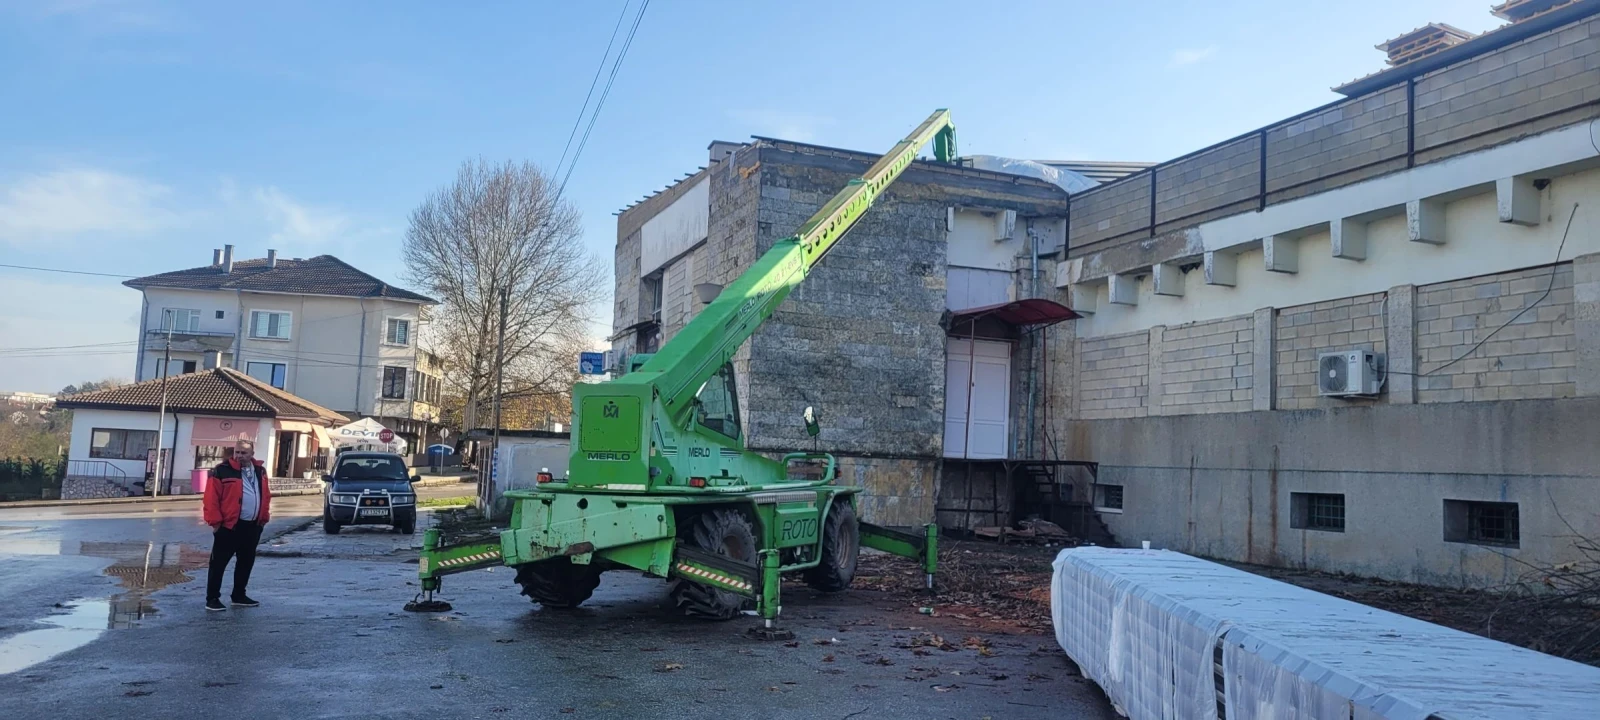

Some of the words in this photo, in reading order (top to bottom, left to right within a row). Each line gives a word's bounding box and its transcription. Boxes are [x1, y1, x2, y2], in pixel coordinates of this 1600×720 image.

[739, 297, 756, 317] MERLO
[756, 281, 772, 301] ROTO
[587, 452, 631, 461] MERLO
[688, 447, 710, 458] MERLO
[781, 517, 818, 541] ROTO
